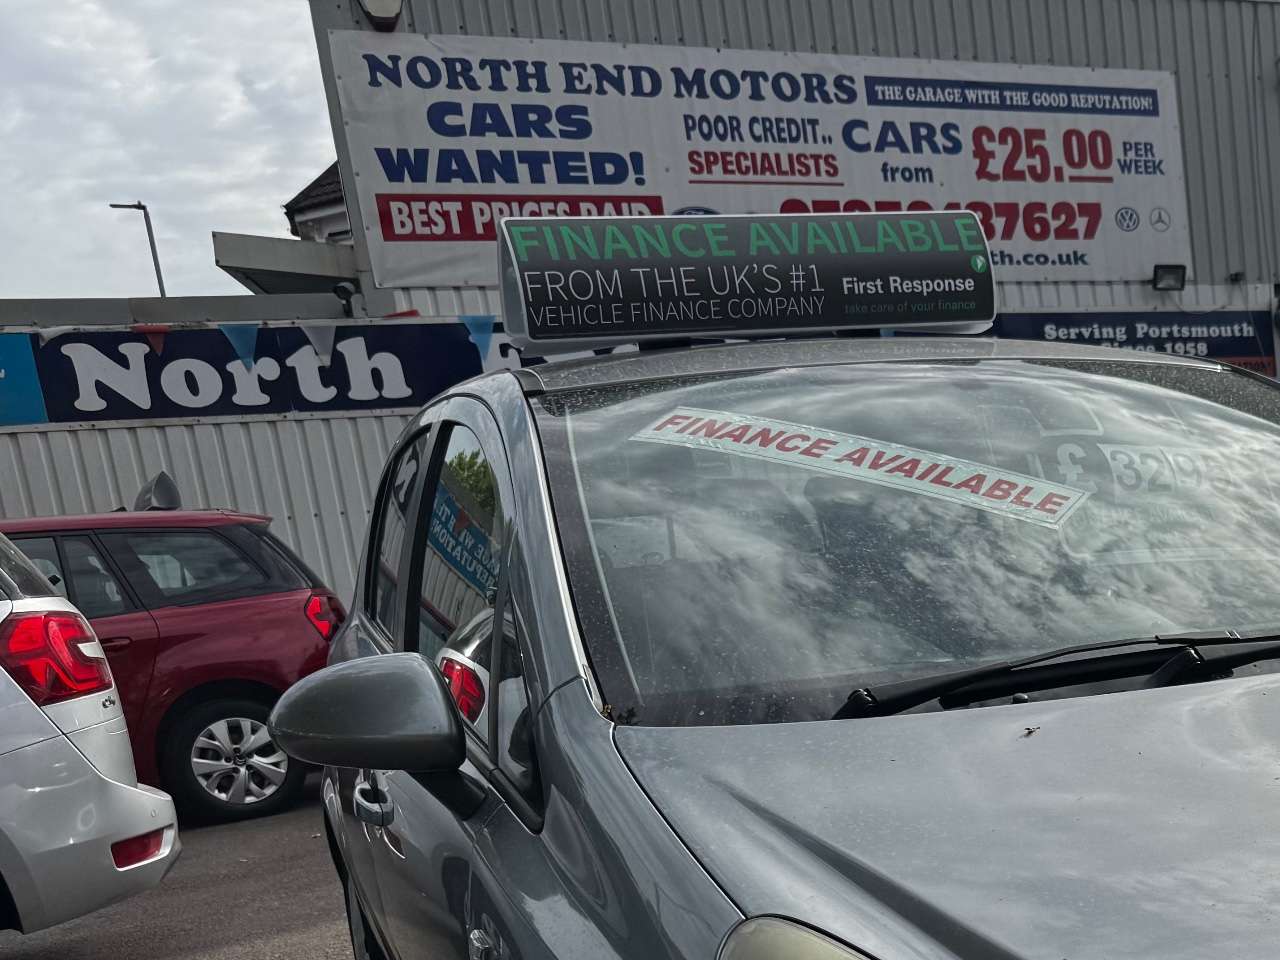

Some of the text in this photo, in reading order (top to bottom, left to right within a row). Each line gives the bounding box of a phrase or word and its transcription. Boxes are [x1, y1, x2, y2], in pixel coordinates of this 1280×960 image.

[362, 54, 858, 104] NORTH END MOTORS
[874, 84, 1153, 111] THE GARAGE WITH THE GOOD REPUTATION!
[426, 101, 593, 140] CARS
[683, 113, 745, 143] POOR
[841, 119, 963, 156] CARS
[1121, 140, 1156, 158] PER
[374, 147, 646, 187] WANTED!
[687, 150, 840, 178] SPECIALISTS
[971, 125, 1114, 184] £25.00
[1116, 158, 1166, 177] WEEK
[880, 161, 934, 184] from
[389, 201, 463, 236] BEST
[509, 221, 737, 263] FINANCE
[750, 217, 985, 257] AVAILABLE
[990, 249, 1089, 267] th.co.uk
[521, 268, 624, 302] FROM
[630, 265, 701, 298] THE
[788, 263, 826, 294] #1
[842, 274, 976, 297] First Response
[528, 294, 826, 328] VEHICLE FINANCE COMPANY
[870, 302, 894, 314] care
[897, 299, 909, 313] of
[911, 302, 935, 316] your
[937, 298, 977, 312] finance
[1044, 321, 1255, 342] Serving Portsmouth
[1163, 342, 1209, 357] 1958
[60, 336, 413, 413] North
[652, 414, 1071, 517] FINANCE AVAILABLE
